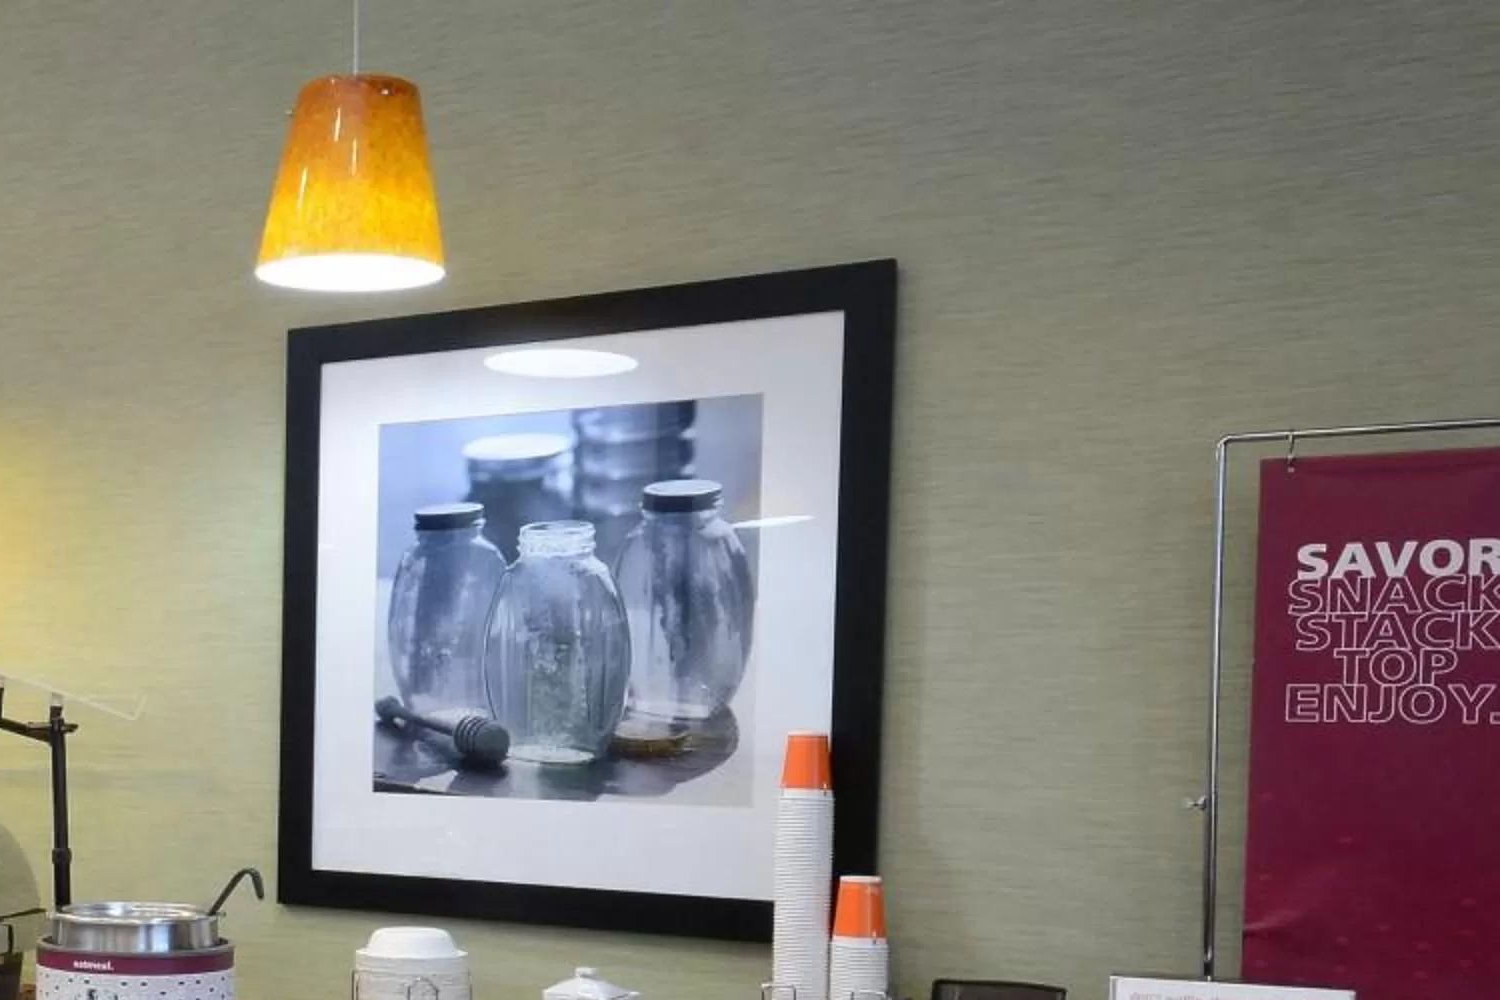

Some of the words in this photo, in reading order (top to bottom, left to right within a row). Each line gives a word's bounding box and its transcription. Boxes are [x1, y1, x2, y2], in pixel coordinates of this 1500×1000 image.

[1297, 538, 1500, 580] SAVOR
[1288, 574, 1500, 615] SNACK
[1296, 609, 1500, 650] STACK
[1333, 648, 1458, 686] TOP
